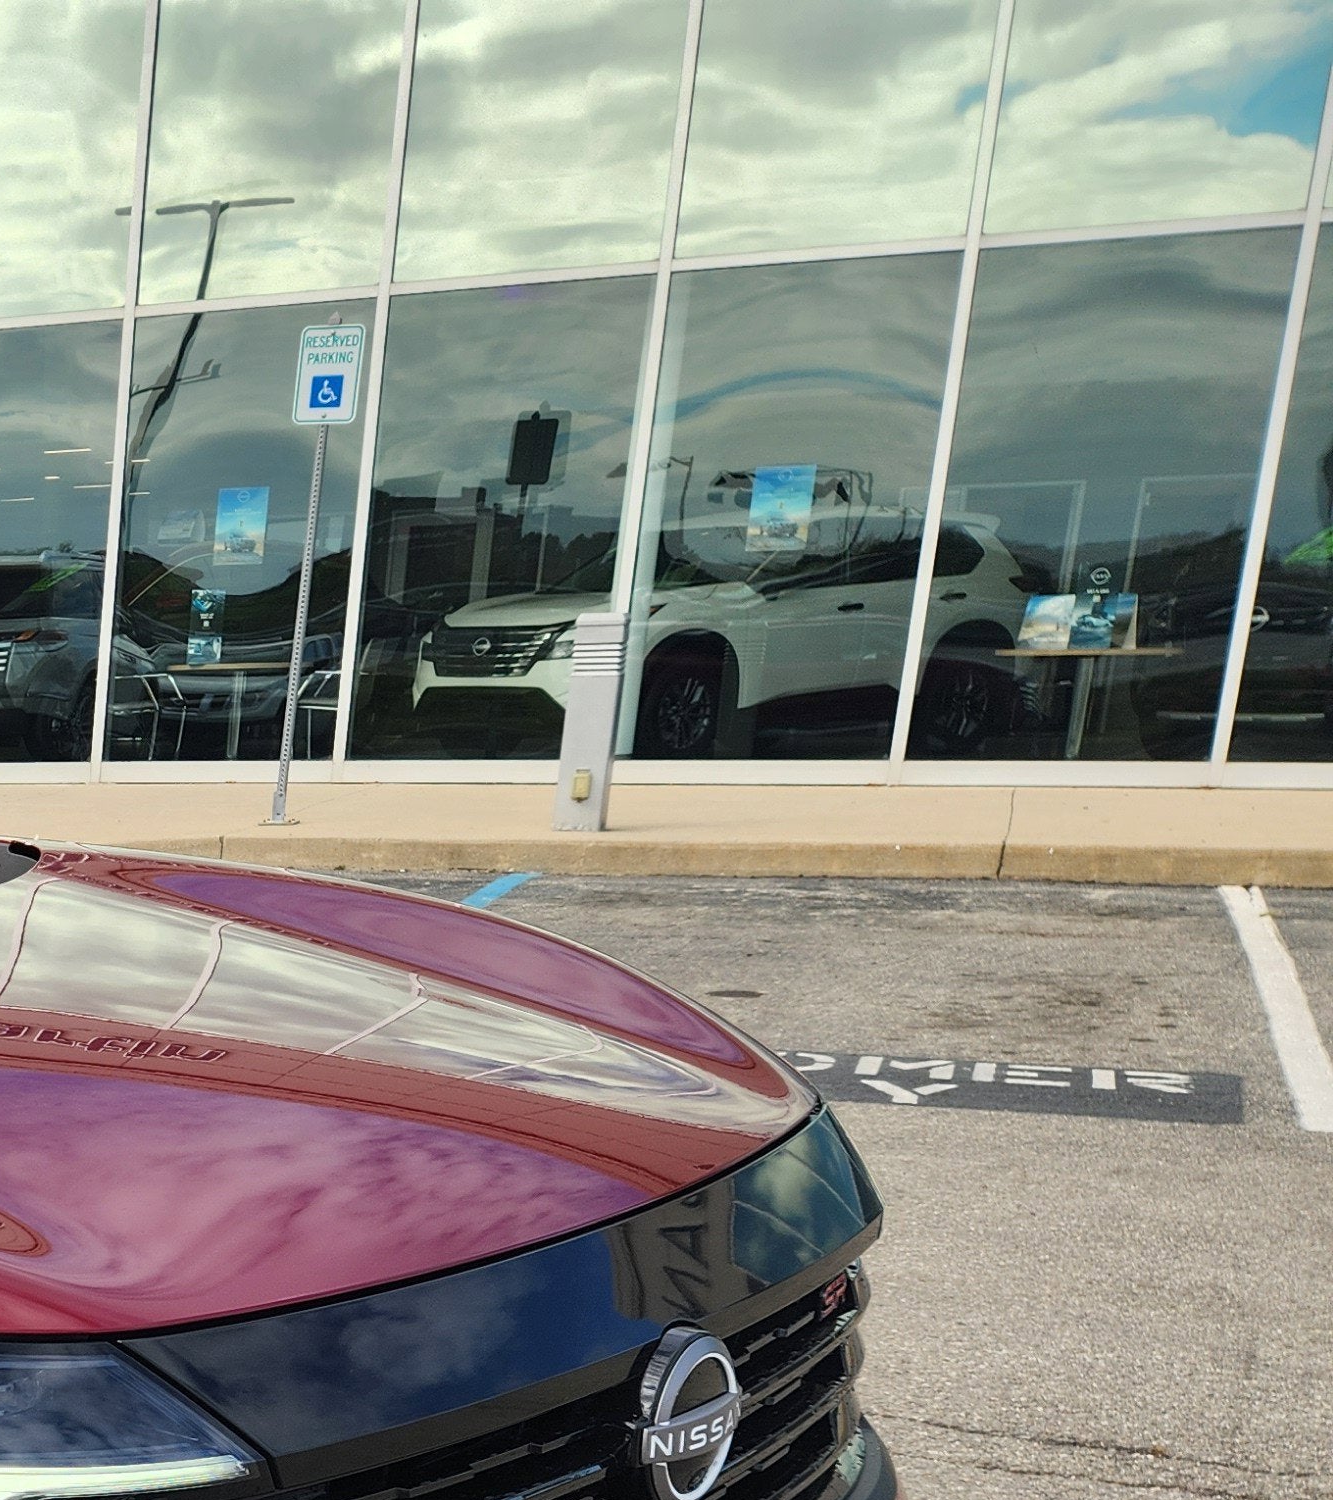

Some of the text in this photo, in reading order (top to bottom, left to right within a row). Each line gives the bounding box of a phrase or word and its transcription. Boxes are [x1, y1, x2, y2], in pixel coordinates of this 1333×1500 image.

[305, 335, 360, 348] RESERVED
[306, 351, 354, 365] PARKING
[819, 1272, 847, 1321] SR
